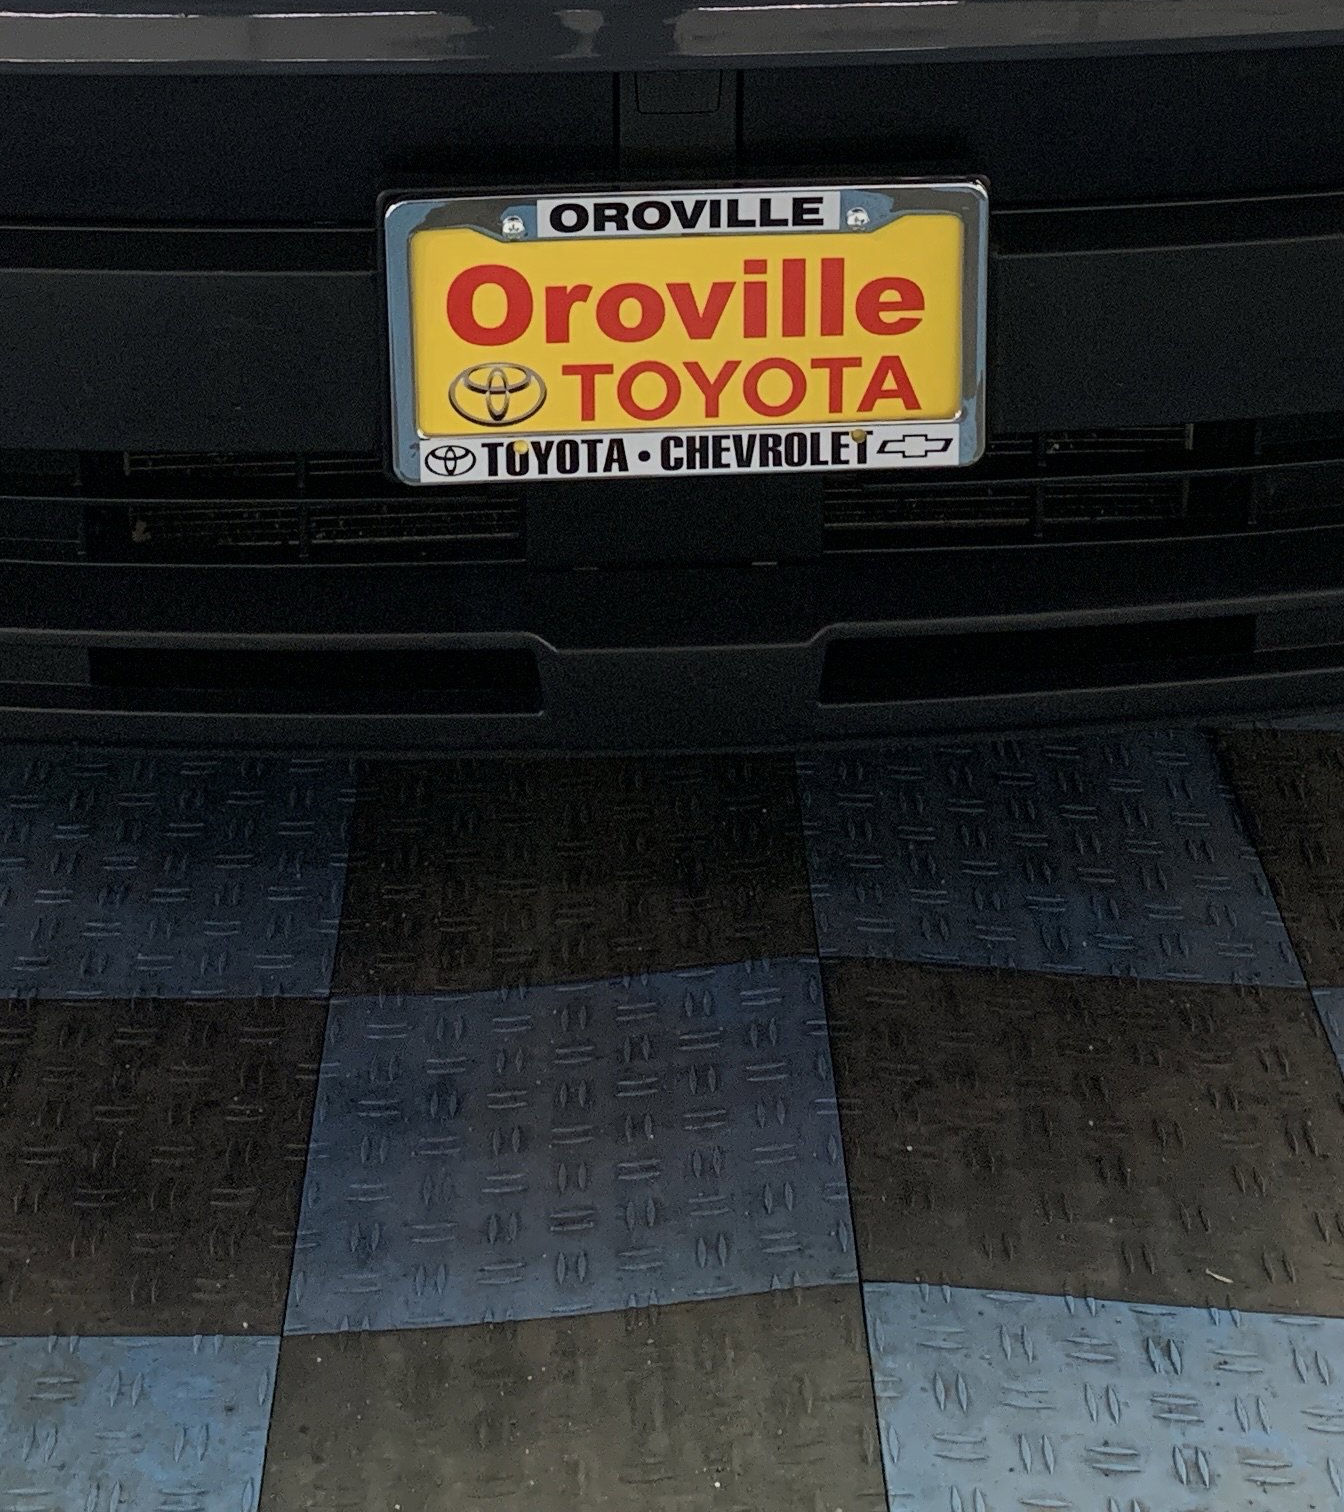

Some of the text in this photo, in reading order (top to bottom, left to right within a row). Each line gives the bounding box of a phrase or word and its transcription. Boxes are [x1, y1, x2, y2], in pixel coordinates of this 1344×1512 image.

[549, 196, 825, 234] OROVILLE
[446, 257, 926, 347] Oroville
[562, 354, 923, 423] TOYOTA
[481, 430, 873, 477] TOYOTA CHEVROLET
